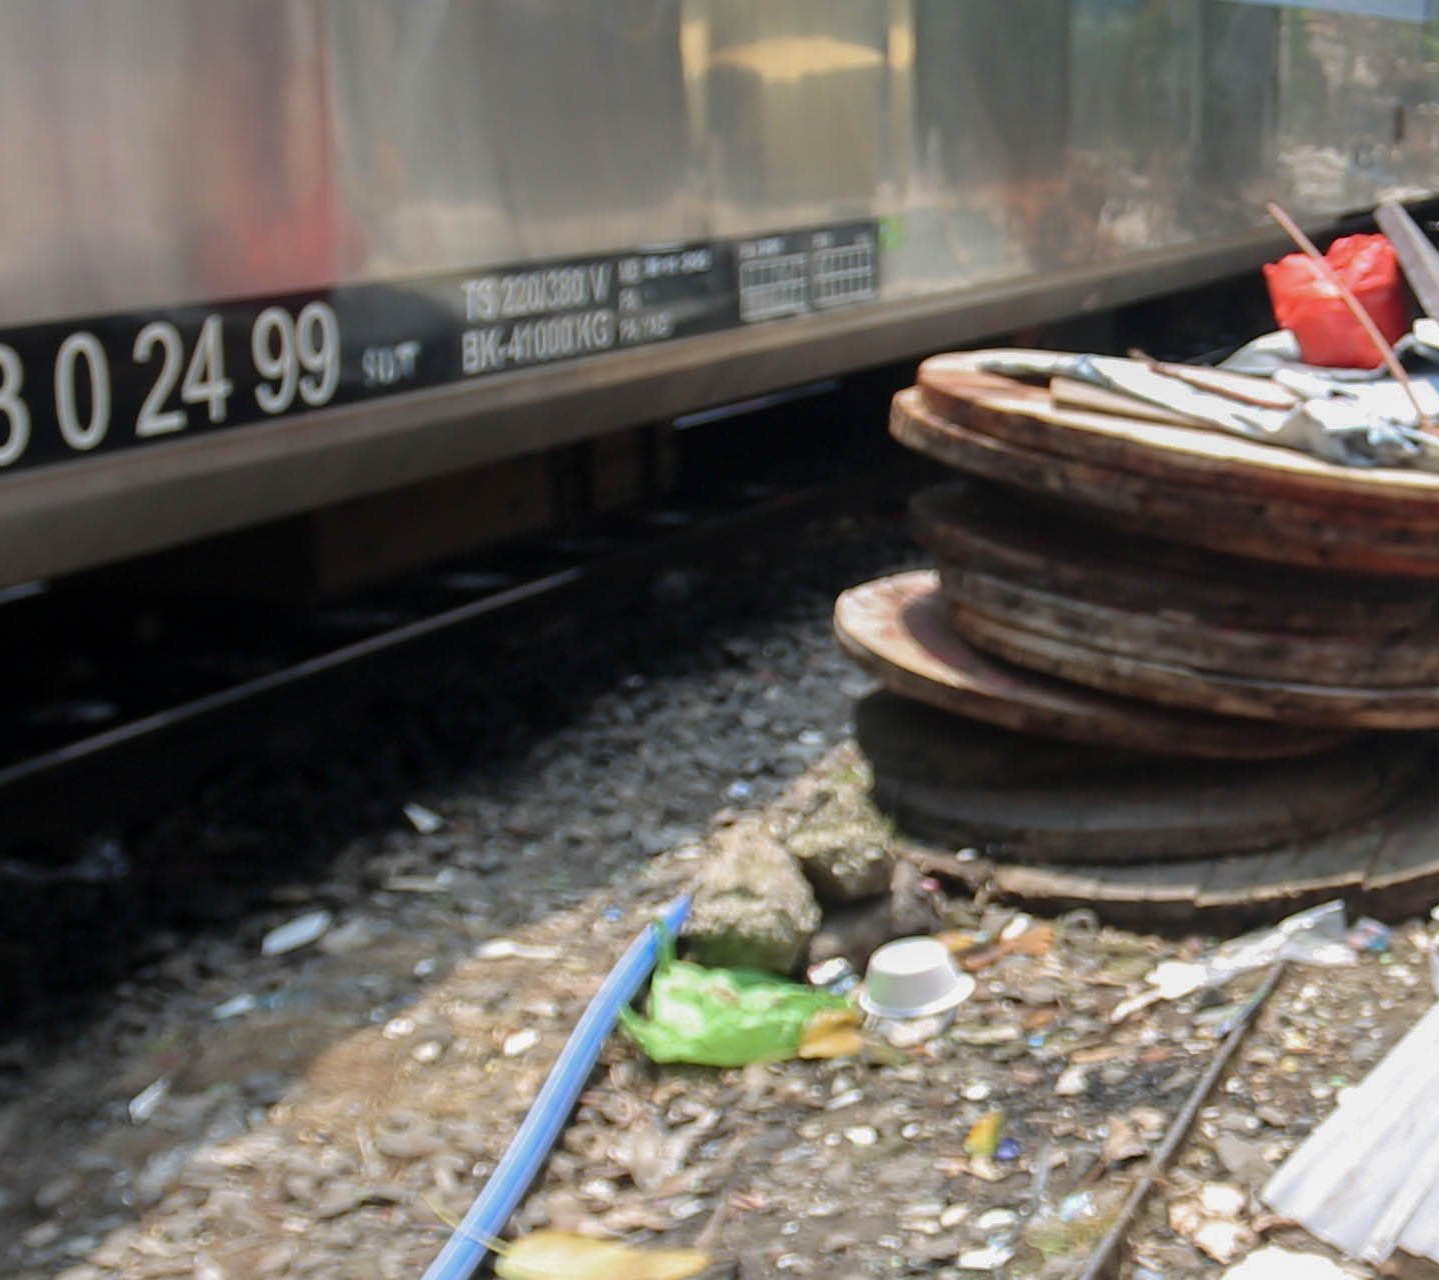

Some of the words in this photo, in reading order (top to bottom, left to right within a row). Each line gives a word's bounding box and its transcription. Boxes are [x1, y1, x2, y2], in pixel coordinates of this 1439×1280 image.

[54, 330, 112, 451] 0
[132, 313, 235, 437] 24
[251, 301, 341, 415] 99
